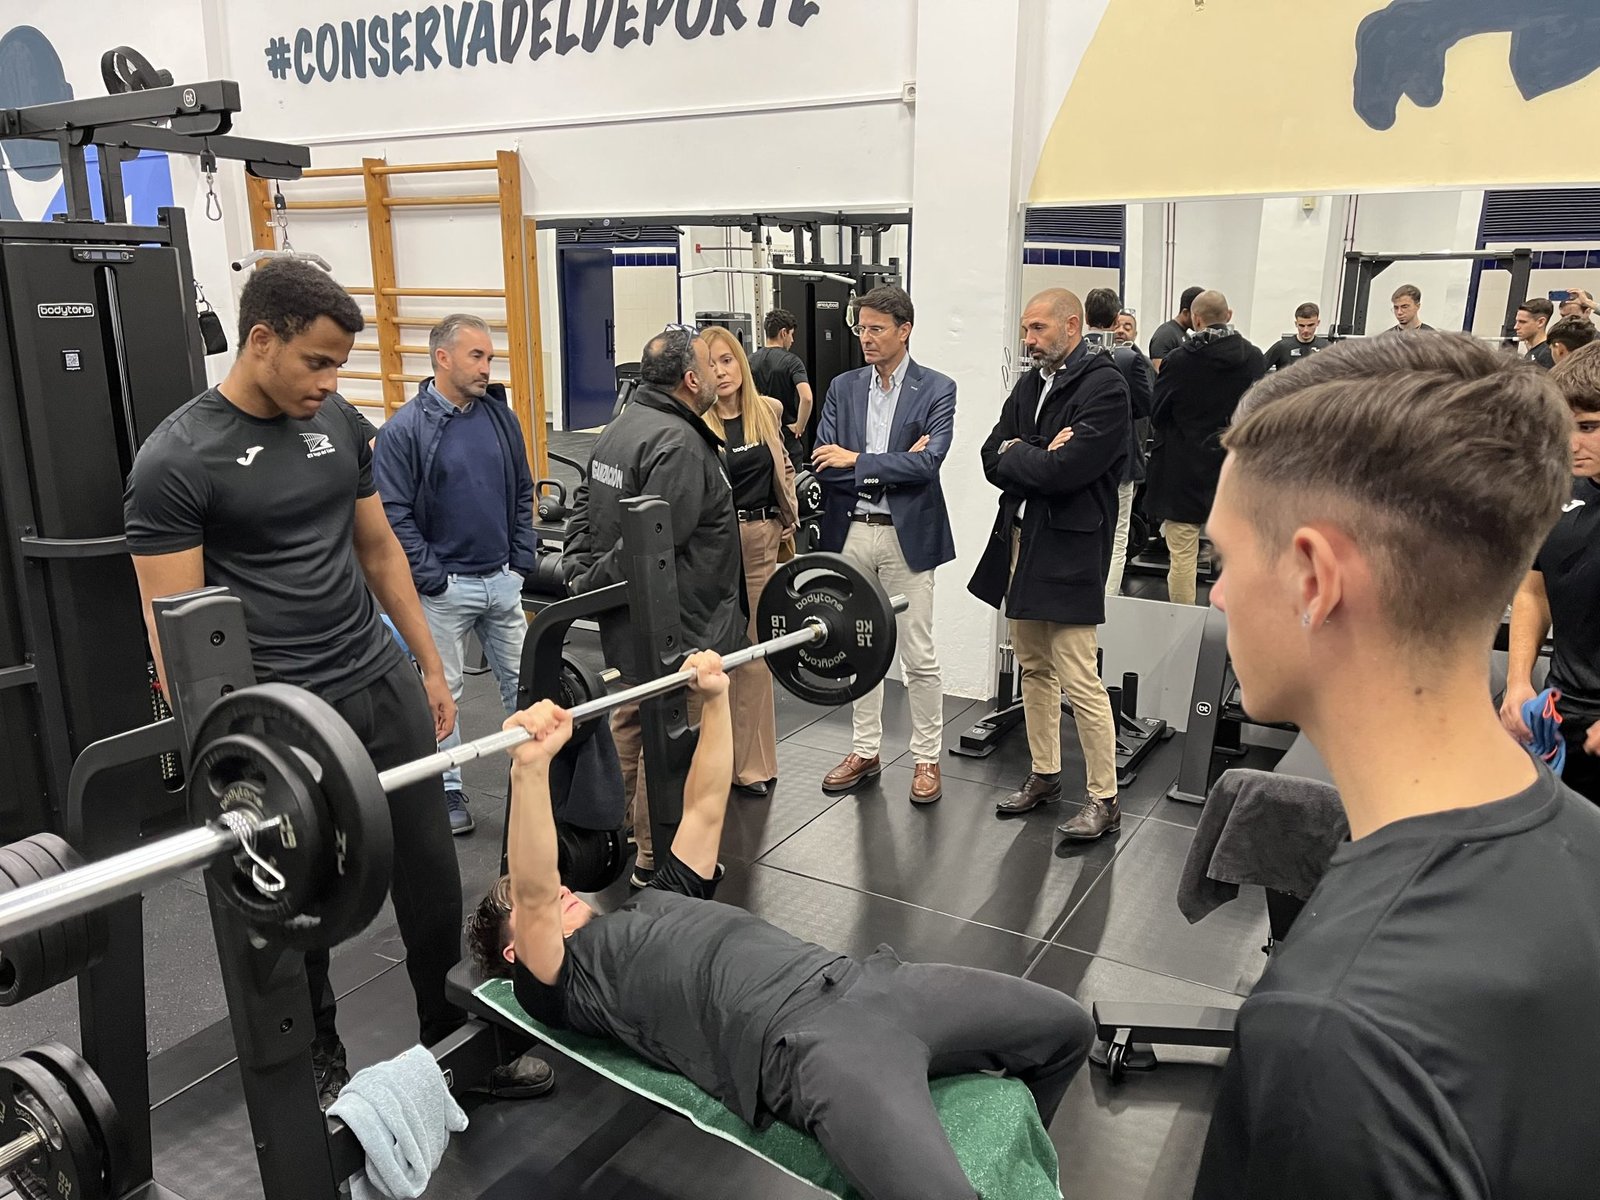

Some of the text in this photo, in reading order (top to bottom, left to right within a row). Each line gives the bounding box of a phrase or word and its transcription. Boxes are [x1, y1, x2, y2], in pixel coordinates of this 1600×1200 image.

[40, 306, 92, 316] bodytone
[795, 592, 844, 613] bodytone
[771, 615, 787, 628] LB
[855, 620, 873, 633] KG
[857, 634, 873, 647] 15
[798, 648, 847, 668] bodytone
